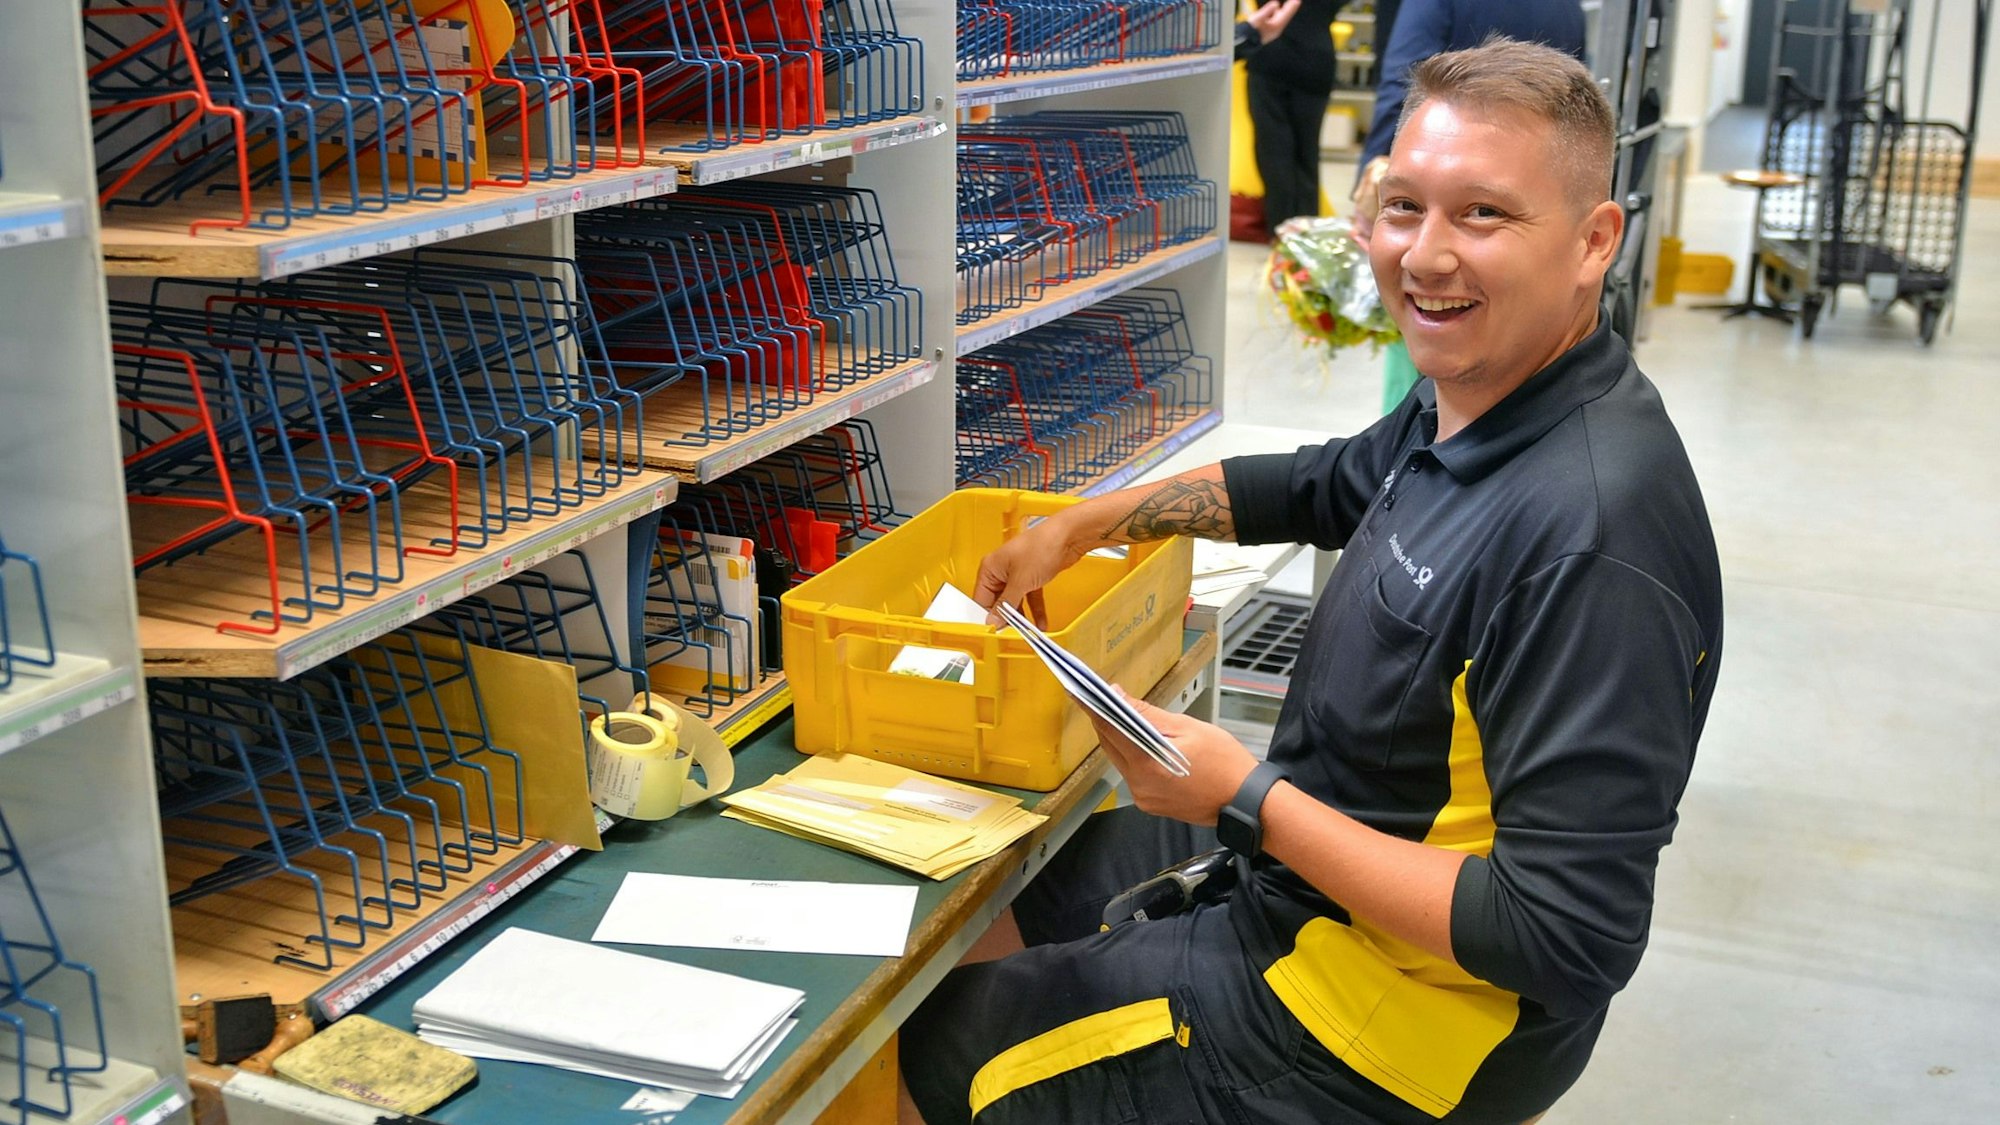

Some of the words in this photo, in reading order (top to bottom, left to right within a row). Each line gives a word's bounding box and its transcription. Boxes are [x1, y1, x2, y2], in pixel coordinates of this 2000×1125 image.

[316, 253, 326, 265] 19
[350, 246, 360, 258] 21
[376, 241, 391, 254] 21a
[1403, 557, 1419, 577] Post
[339, 1001, 347, 1012] 2
[350, 992, 363, 1004] 2a
[364, 982, 378, 994] 2b
[379, 972, 393, 985] 2c
[397, 961, 405, 972] 4
[409, 952, 419, 962] 6
[423, 943, 432, 953] 8
[436, 931, 448, 944] 10
[450, 922, 462, 935] 11
[464, 914, 472, 925] 7
[503, 888, 511, 898] 5
[537, 862, 548, 875] 12
